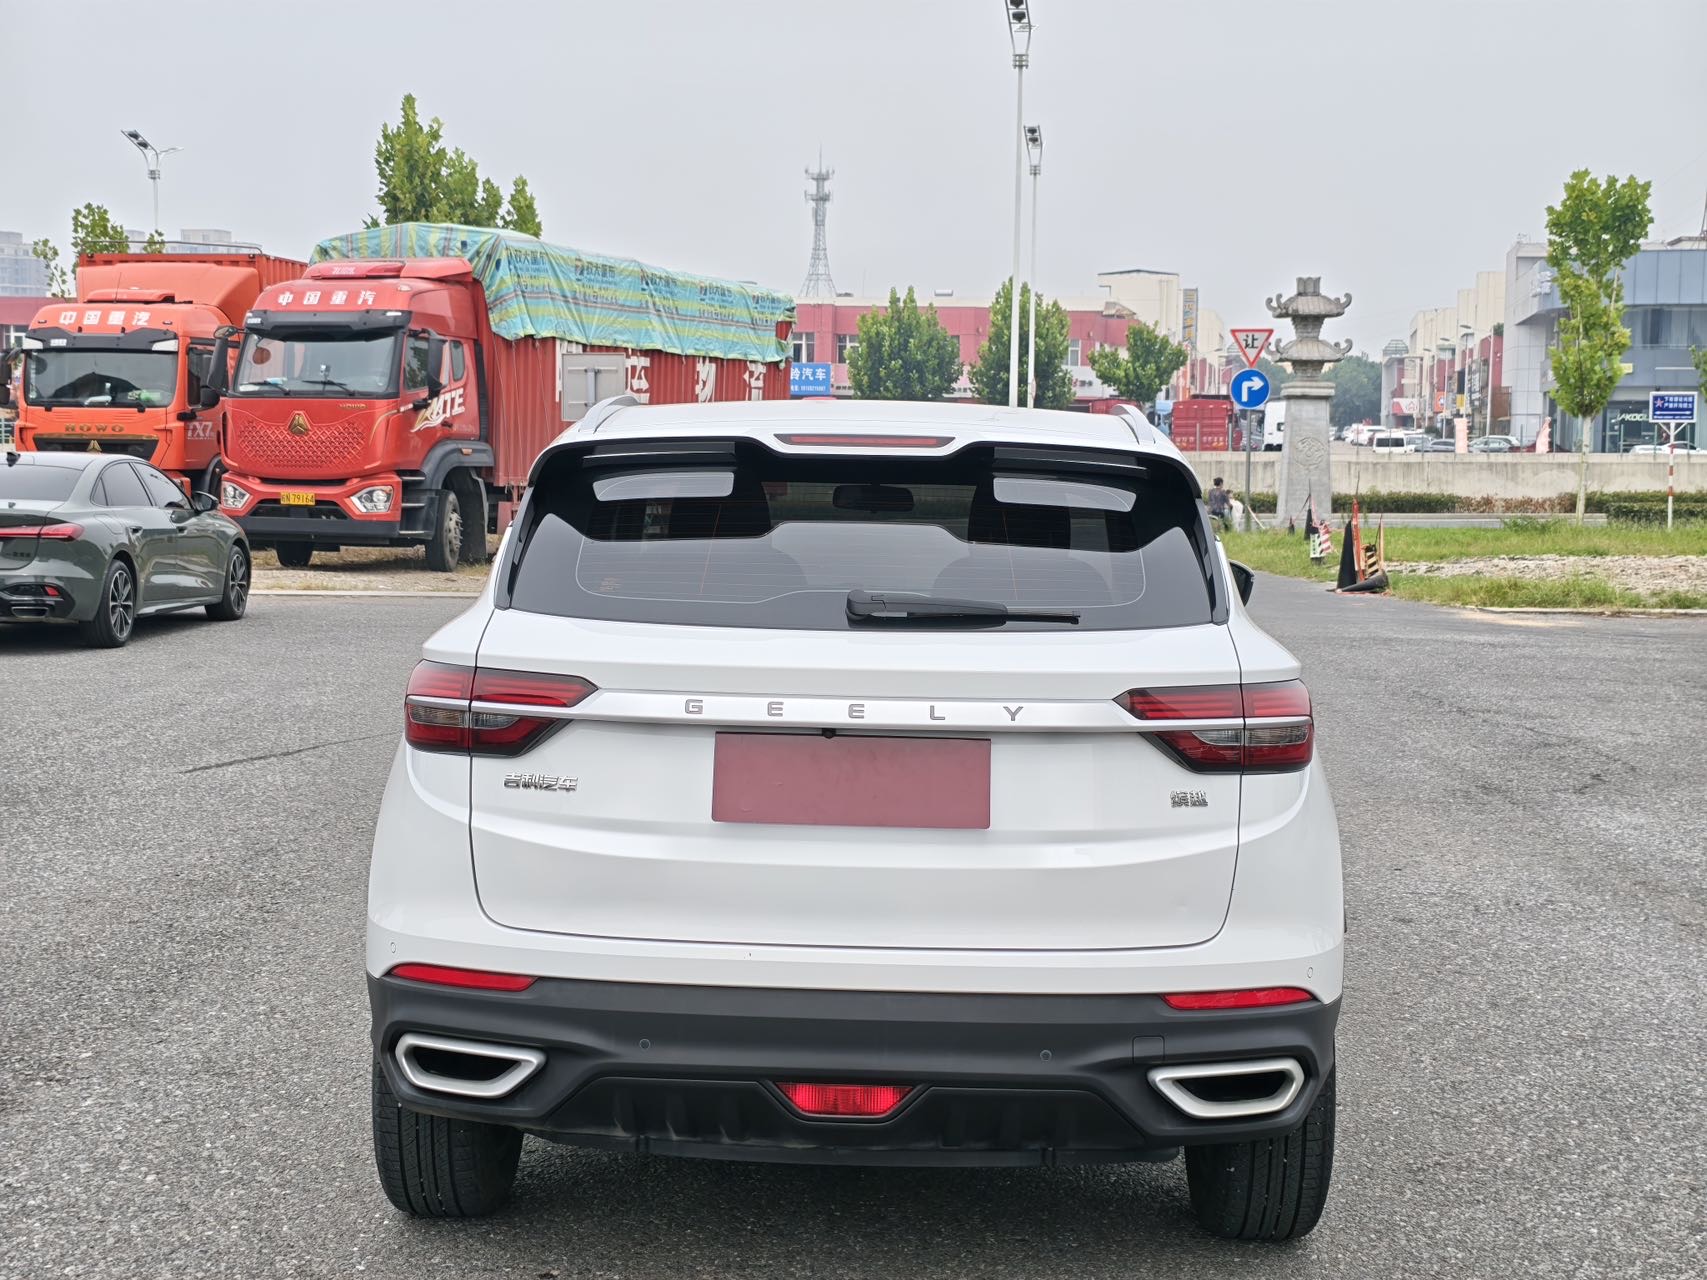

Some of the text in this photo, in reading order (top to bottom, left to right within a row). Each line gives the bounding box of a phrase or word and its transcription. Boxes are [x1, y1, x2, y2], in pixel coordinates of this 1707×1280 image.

[278, 290, 376, 305] 中国重汽
[59, 310, 151, 325] 中国重汽
[1243, 334, 1259, 349] 让
[65, 424, 124, 432] HOWO
[684, 698, 1024, 722] GEELY
[503, 772, 579, 792] 吉利汽车
